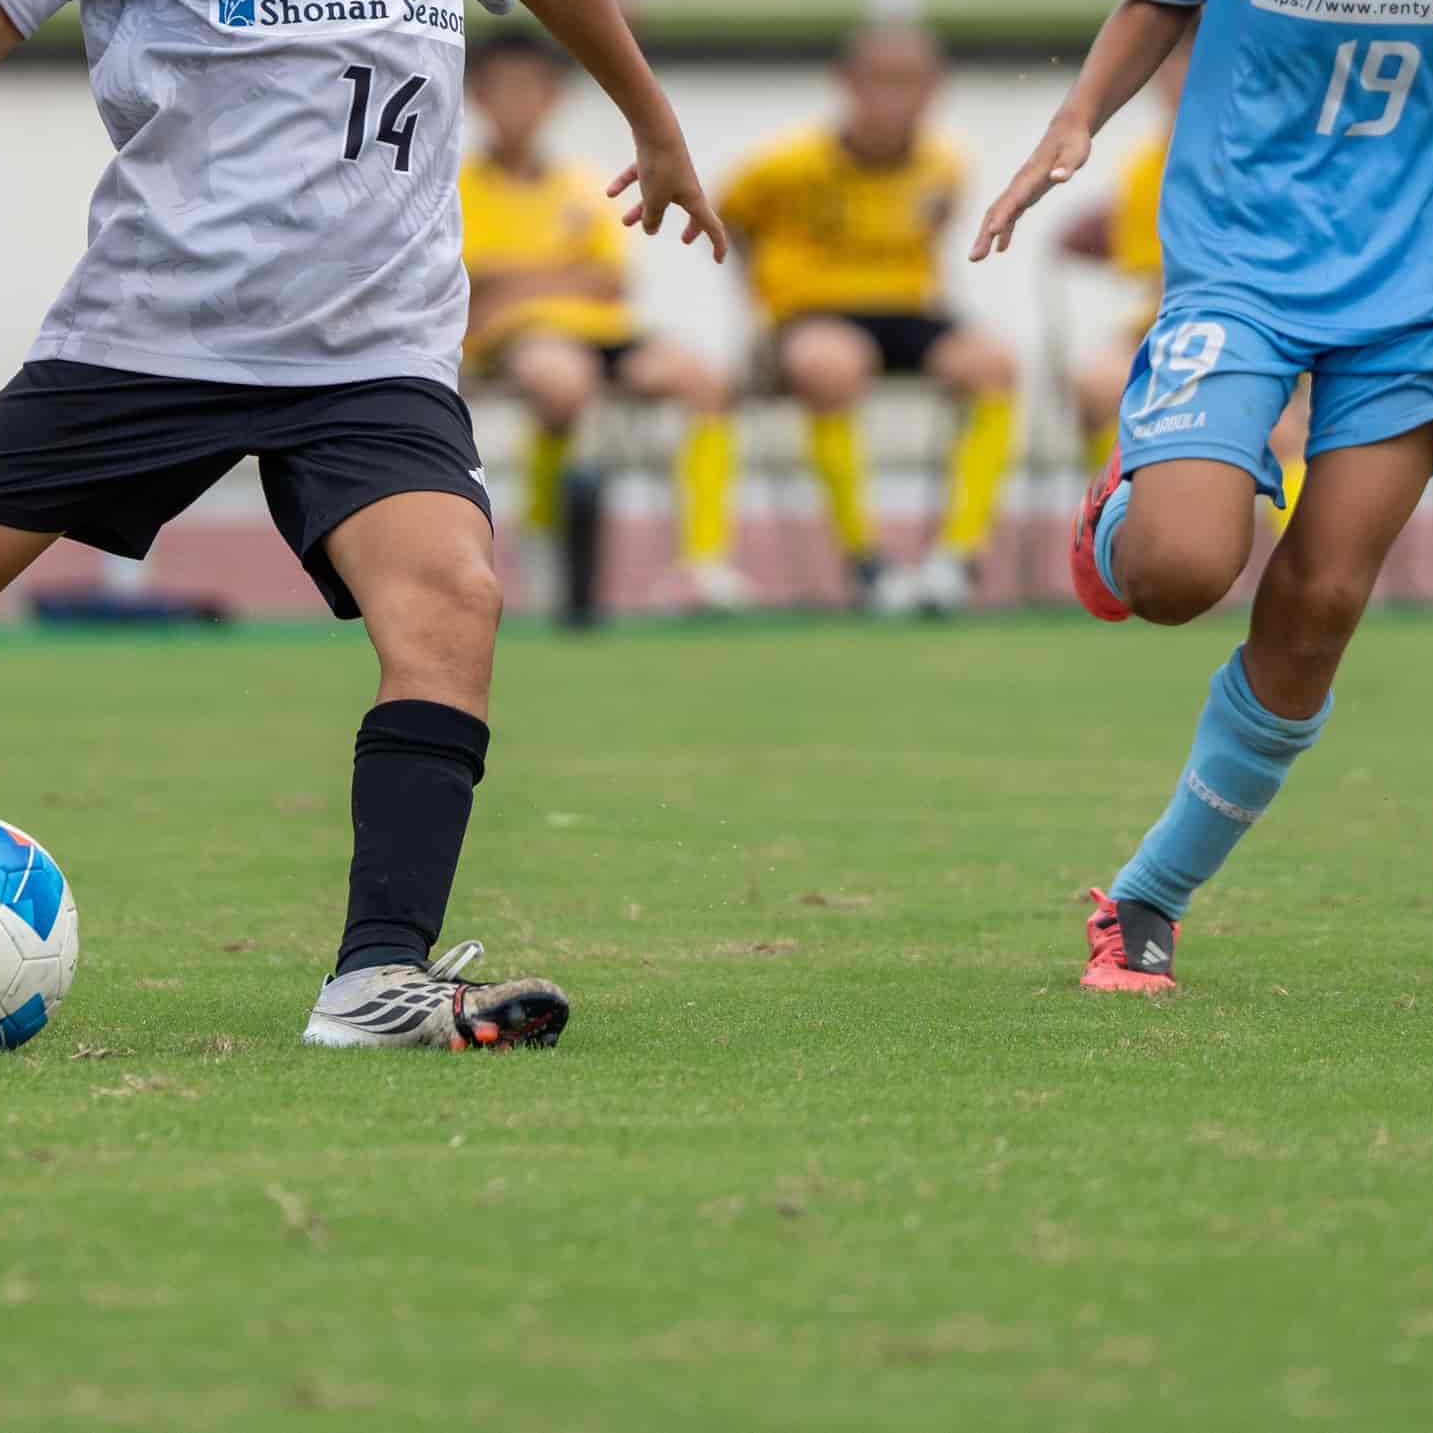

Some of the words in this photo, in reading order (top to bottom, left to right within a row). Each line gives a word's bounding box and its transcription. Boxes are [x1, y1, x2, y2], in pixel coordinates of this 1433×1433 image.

[341, 63, 432, 175] 14
[1315, 39, 1423, 137] 19
[1127, 321, 1226, 419] 19
